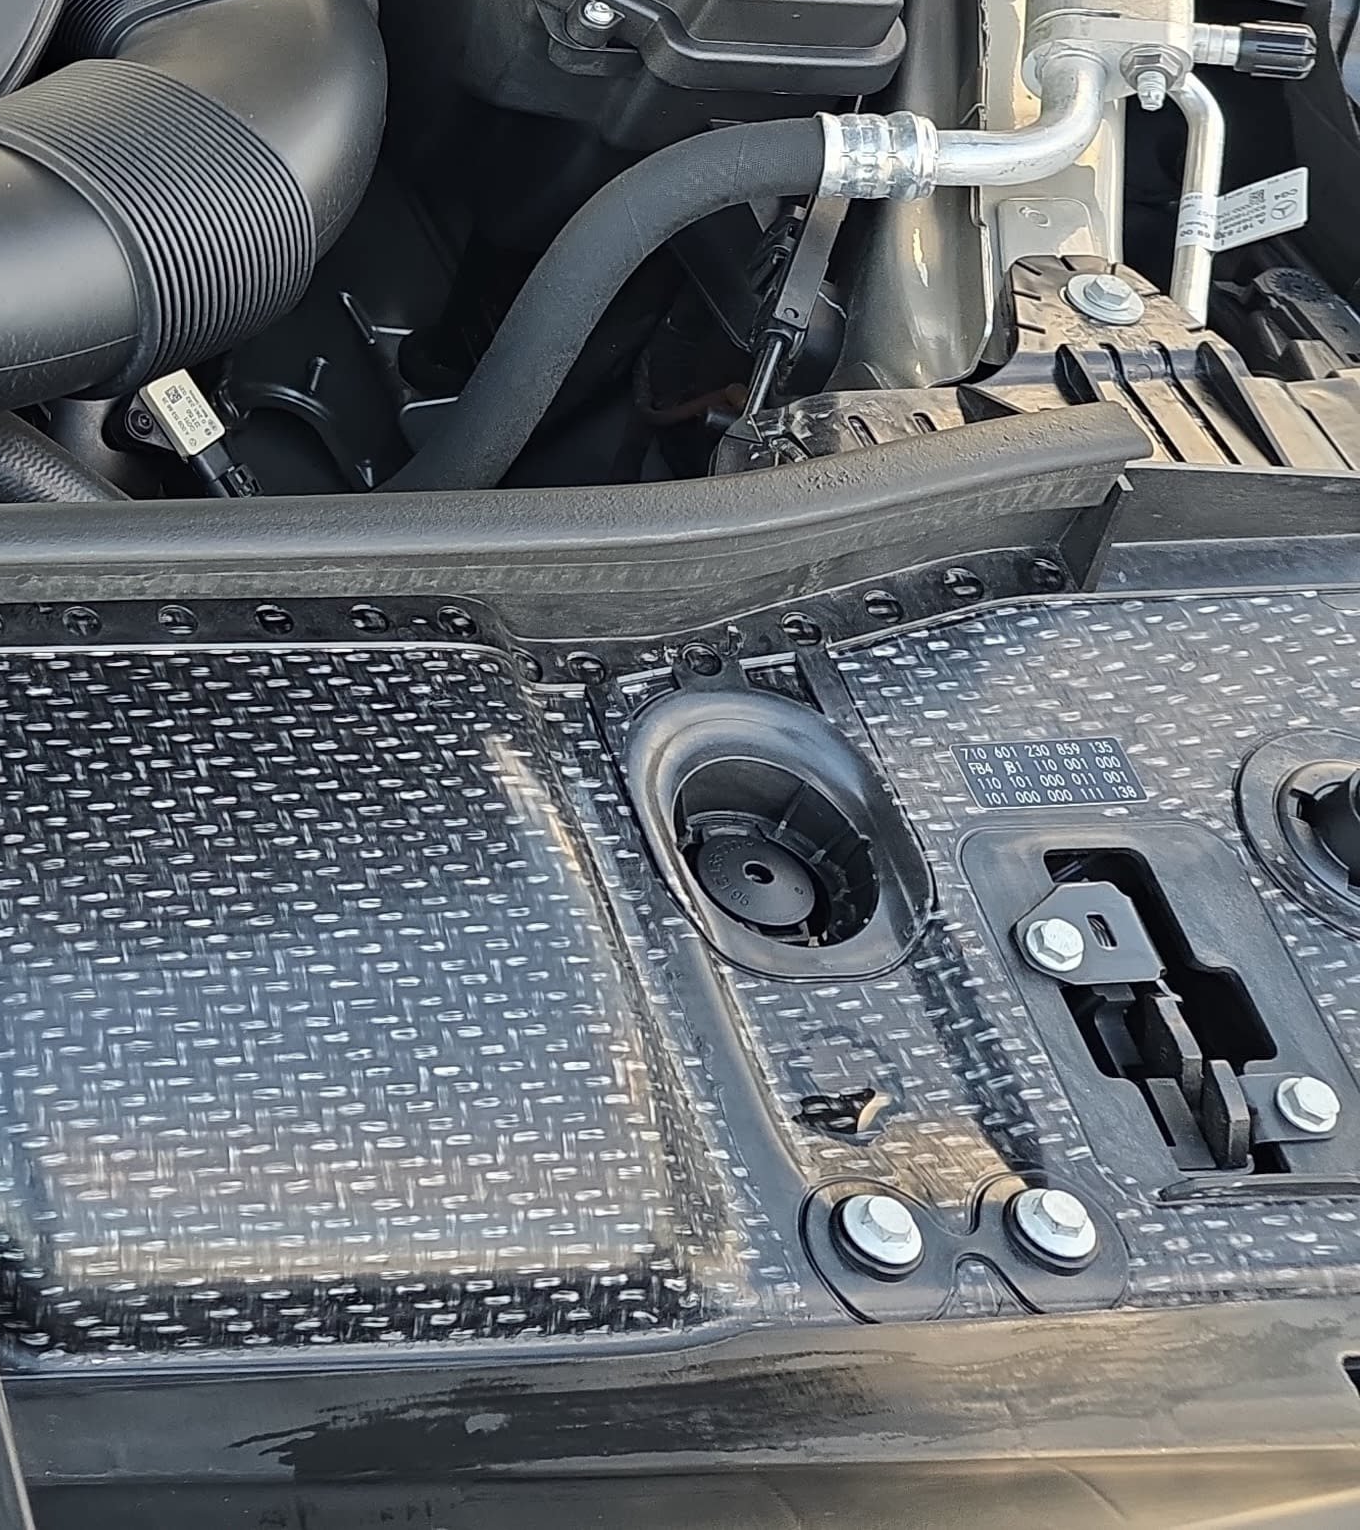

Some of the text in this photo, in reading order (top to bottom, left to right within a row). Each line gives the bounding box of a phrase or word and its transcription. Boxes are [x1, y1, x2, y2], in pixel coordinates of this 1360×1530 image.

[960, 741, 1113, 761] 710 601 230 859 135
[968, 762, 994, 775] FB4
[1033, 759, 1058, 772] 110
[1063, 758, 1089, 770] 001
[1095, 756, 1121, 769] 000
[977, 771, 1129, 791] 110 101 000 011 001
[984, 786, 1138, 806] 101 000 000 111 138
